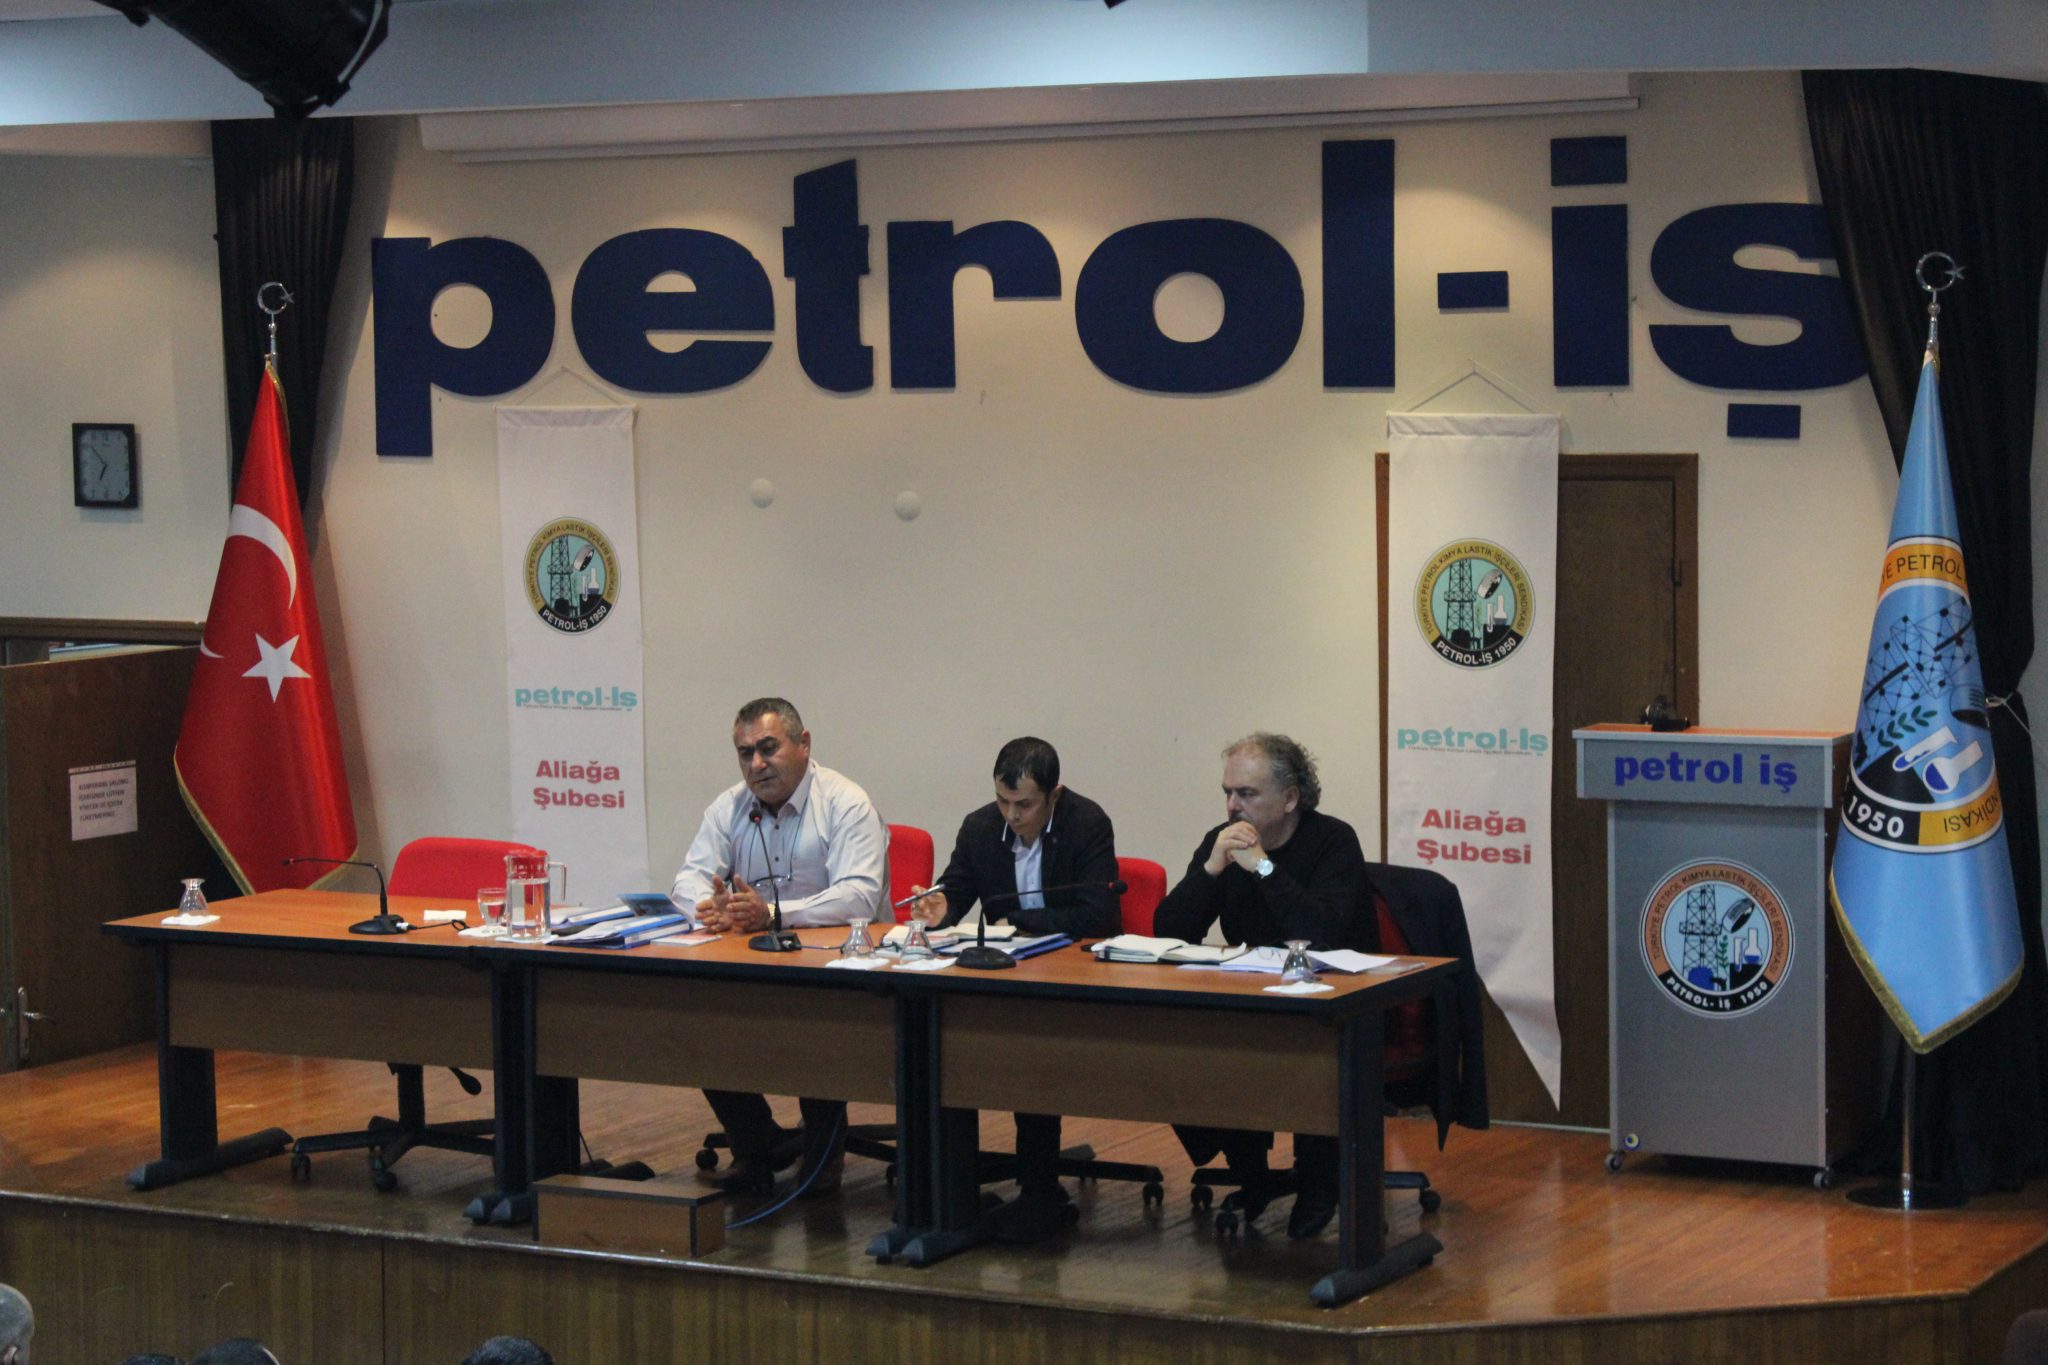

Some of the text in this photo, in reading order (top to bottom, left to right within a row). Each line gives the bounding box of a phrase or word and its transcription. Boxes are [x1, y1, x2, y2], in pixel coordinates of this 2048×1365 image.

[371, 136, 1867, 457] petrol-iş
[1421, 564, 1440, 595] PETROL
[1896, 554, 1963, 580] PETROL
[590, 605, 607, 623] 1950
[1495, 637, 1516, 659] 1950
[535, 760, 620, 784] Aliağa
[1614, 751, 1798, 793] petrol iş
[533, 787, 625, 810] Şubesi
[1421, 808, 1526, 836] Aliağa
[1848, 795, 1904, 838] 1950
[1416, 838, 1531, 865] Şubesi
[1681, 869, 1710, 885] KİMYA
[1740, 981, 1768, 1003] 1950
